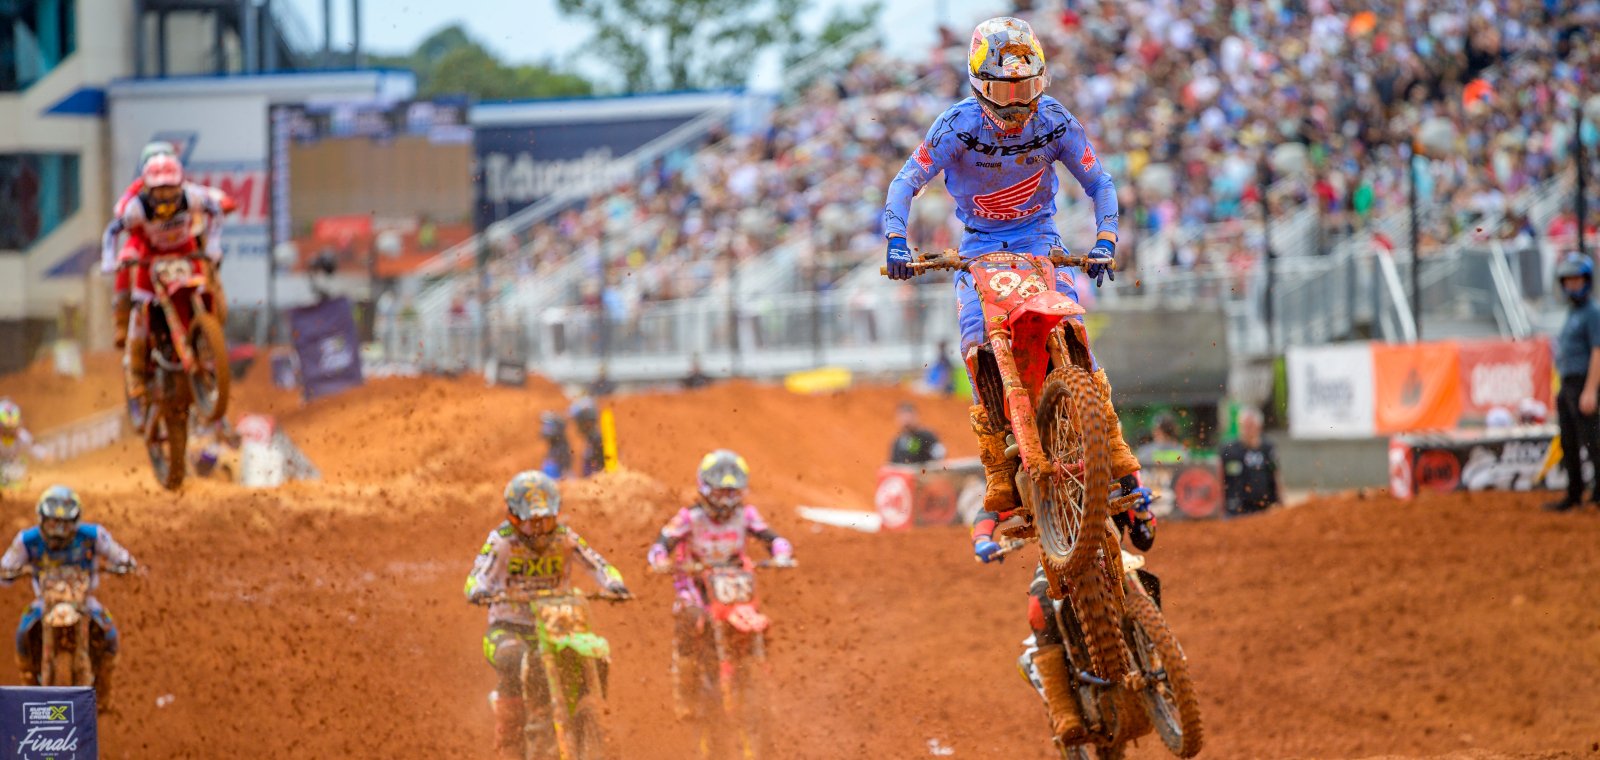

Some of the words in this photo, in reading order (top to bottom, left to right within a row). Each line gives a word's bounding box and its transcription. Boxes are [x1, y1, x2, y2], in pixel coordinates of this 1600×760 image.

[956, 122, 1067, 156] alpinestars
[974, 204, 1042, 220] HONDA
[989, 271, 1048, 298] 96
[17, 726, 79, 754] Finals
